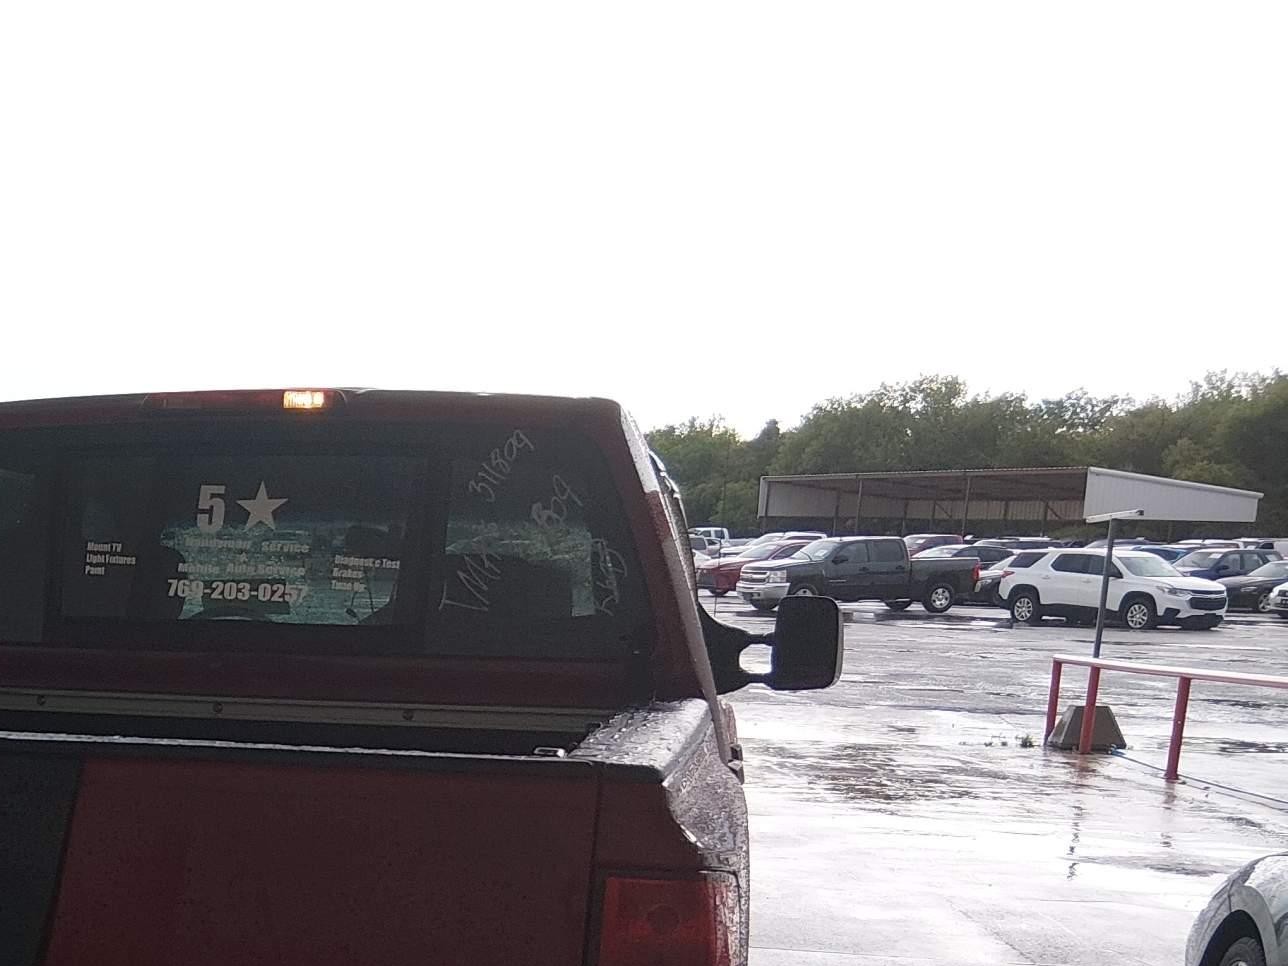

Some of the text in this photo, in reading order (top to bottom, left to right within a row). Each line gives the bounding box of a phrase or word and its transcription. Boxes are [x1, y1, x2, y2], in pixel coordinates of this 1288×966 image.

[197, 484, 226, 533] 5
[262, 541, 310, 553] Service
[86, 552, 105, 563] Light
[382, 558, 401, 569] Test
